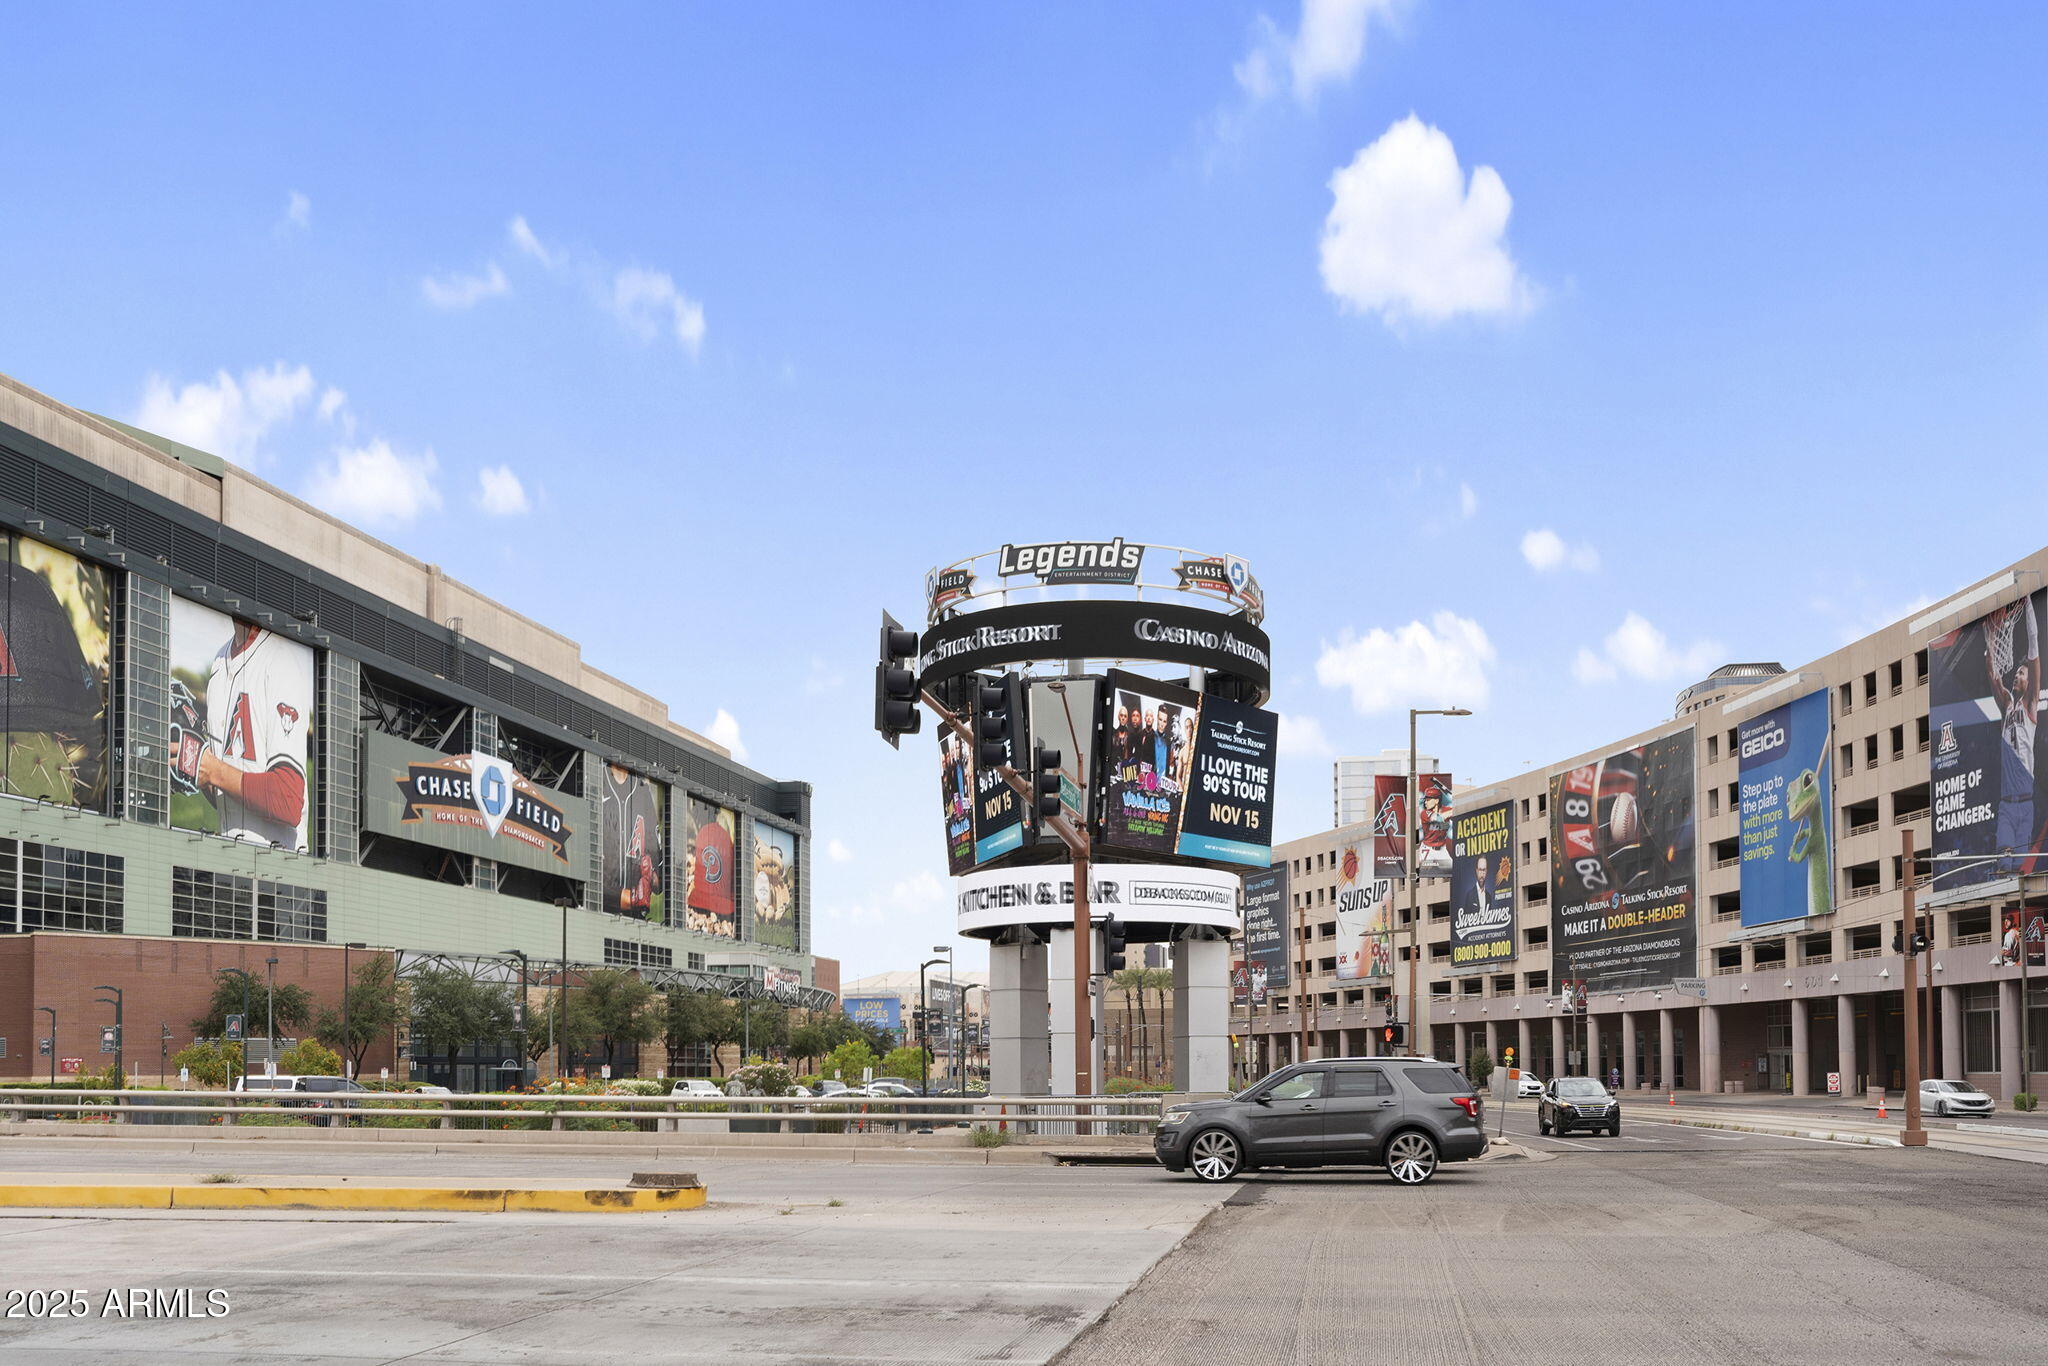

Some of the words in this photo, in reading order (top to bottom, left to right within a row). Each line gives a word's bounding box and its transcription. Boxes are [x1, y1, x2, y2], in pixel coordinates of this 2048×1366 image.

[1000, 538, 1140, 574] Legends
[941, 575, 964, 589] FIELD
[1187, 565, 1222, 578] CHASE
[1134, 618, 1219, 649] CASINO
[1211, 728, 1232, 742] TALKING
[1233, 734, 1247, 746] STICK
[1247, 737, 1267, 750] RESORT
[1742, 730, 1750, 740] Get
[1751, 725, 1764, 736] more
[1765, 720, 1775, 731] with
[1742, 727, 1784, 759] GEICO
[1201, 753, 1205, 771] I
[1208, 755, 1242, 779] LOVE
[1244, 763, 1269, 785] THE
[416, 775, 471, 800] CHASE
[1203, 774, 1230, 796] 90'S
[1232, 780, 1266, 803] TOUR
[1742, 783, 1761, 800] Step
[1763, 779, 1774, 795] up
[1774, 775, 1784, 788] to
[1935, 773, 1966, 798] HOME
[1968, 768, 1982, 789] OF
[516, 797, 561, 833] FIELD
[985, 796, 1002, 820] NOV
[1003, 789, 1012, 812] 15
[1210, 802, 1241, 826] NOV
[1244, 809, 1260, 829] 15
[1743, 801, 1757, 815] the
[1758, 793, 1778, 814] plate
[1935, 792, 1965, 816] GAME
[436, 812, 455, 821] HOME
[459, 814, 467, 822] OF
[471, 816, 483, 826] THE
[1457, 808, 1507, 840] ACCIDENT
[1743, 813, 1760, 829] with
[1762, 808, 1783, 822] more
[1935, 802, 1995, 833] CHANGERS.
[503, 825, 545, 848] DIAMONDBACKS
[1455, 842, 1466, 857] OR
[1466, 828, 1509, 857] INJURY?
[1743, 830, 1762, 845] than
[1763, 825, 1778, 844] just
[1743, 842, 1775, 862] savings.
[1247, 895, 1261, 907] Large
[1262, 890, 1280, 902] format
[1373, 880, 1388, 903] UP
[1561, 904, 1582, 916] CASINO
[1584, 900, 1610, 912] ARIZONA
[1621, 892, 1646, 905] TALKING
[1647, 888, 1664, 901] STICK
[1664, 884, 1688, 897] RESORT
[1247, 906, 1270, 920] graphics
[1480, 903, 1511, 924] James
[1564, 922, 1589, 936] MAKE
[1590, 918, 1598, 933] IT
[1600, 917, 1607, 931] A
[1608, 903, 1686, 930] DOUBLE-HEADER
[1256, 932, 1267, 942] first
[1268, 931, 1281, 941] time.
[1467, 933, 1485, 942] ACCIDENT
[1485, 930, 1507, 939] ATTORNEYS
[1454, 944, 1473, 963] (800)
[1474, 940, 1511, 960] 900-0000
[1585, 948, 1606, 959] PARTNER
[1606, 947, 1612, 955] OF
[1613, 945, 1622, 954] THE
[1622, 942, 1642, 954] ARIZONA
[1642, 938, 1681, 951] DIAMONDBACKS
[775, 977, 800, 994] FITNESS
[855, 1009, 889, 1018] PRICES
[860, 1001, 884, 1010] LOW
